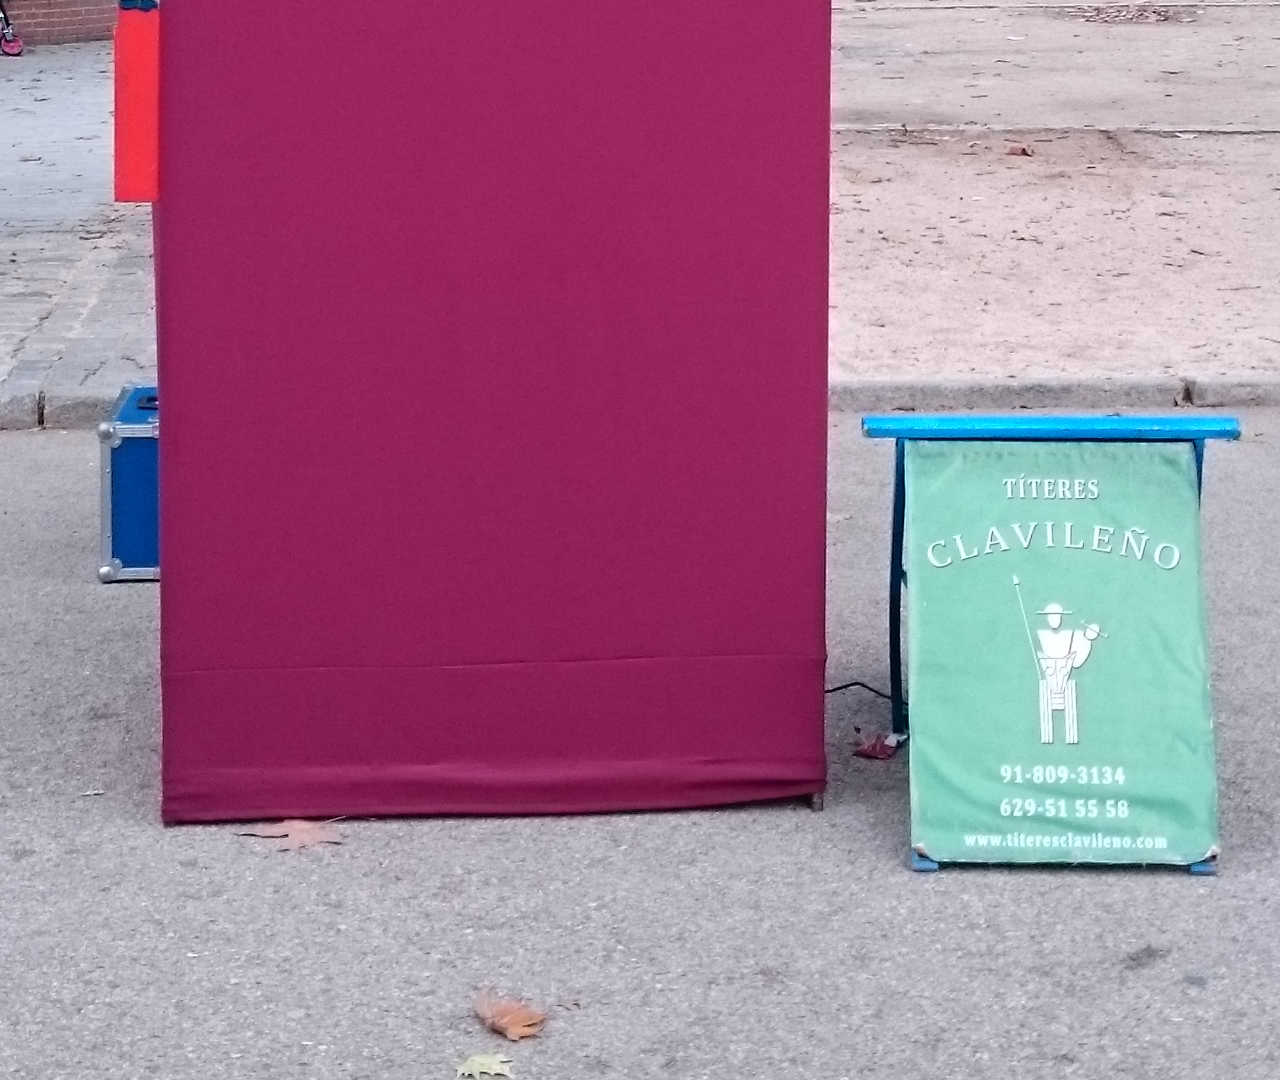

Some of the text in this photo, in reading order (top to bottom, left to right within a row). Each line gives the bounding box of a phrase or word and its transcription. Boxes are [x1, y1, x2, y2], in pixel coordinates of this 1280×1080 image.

[1002, 473, 1100, 500] TÍTERES
[926, 521, 1181, 571] CLAVILEÑO
[999, 765, 1125, 785] 91-809-3134
[999, 798, 1129, 818] 629-51 55 58
[964, 832, 1168, 849] www.titeresclavileno.com
